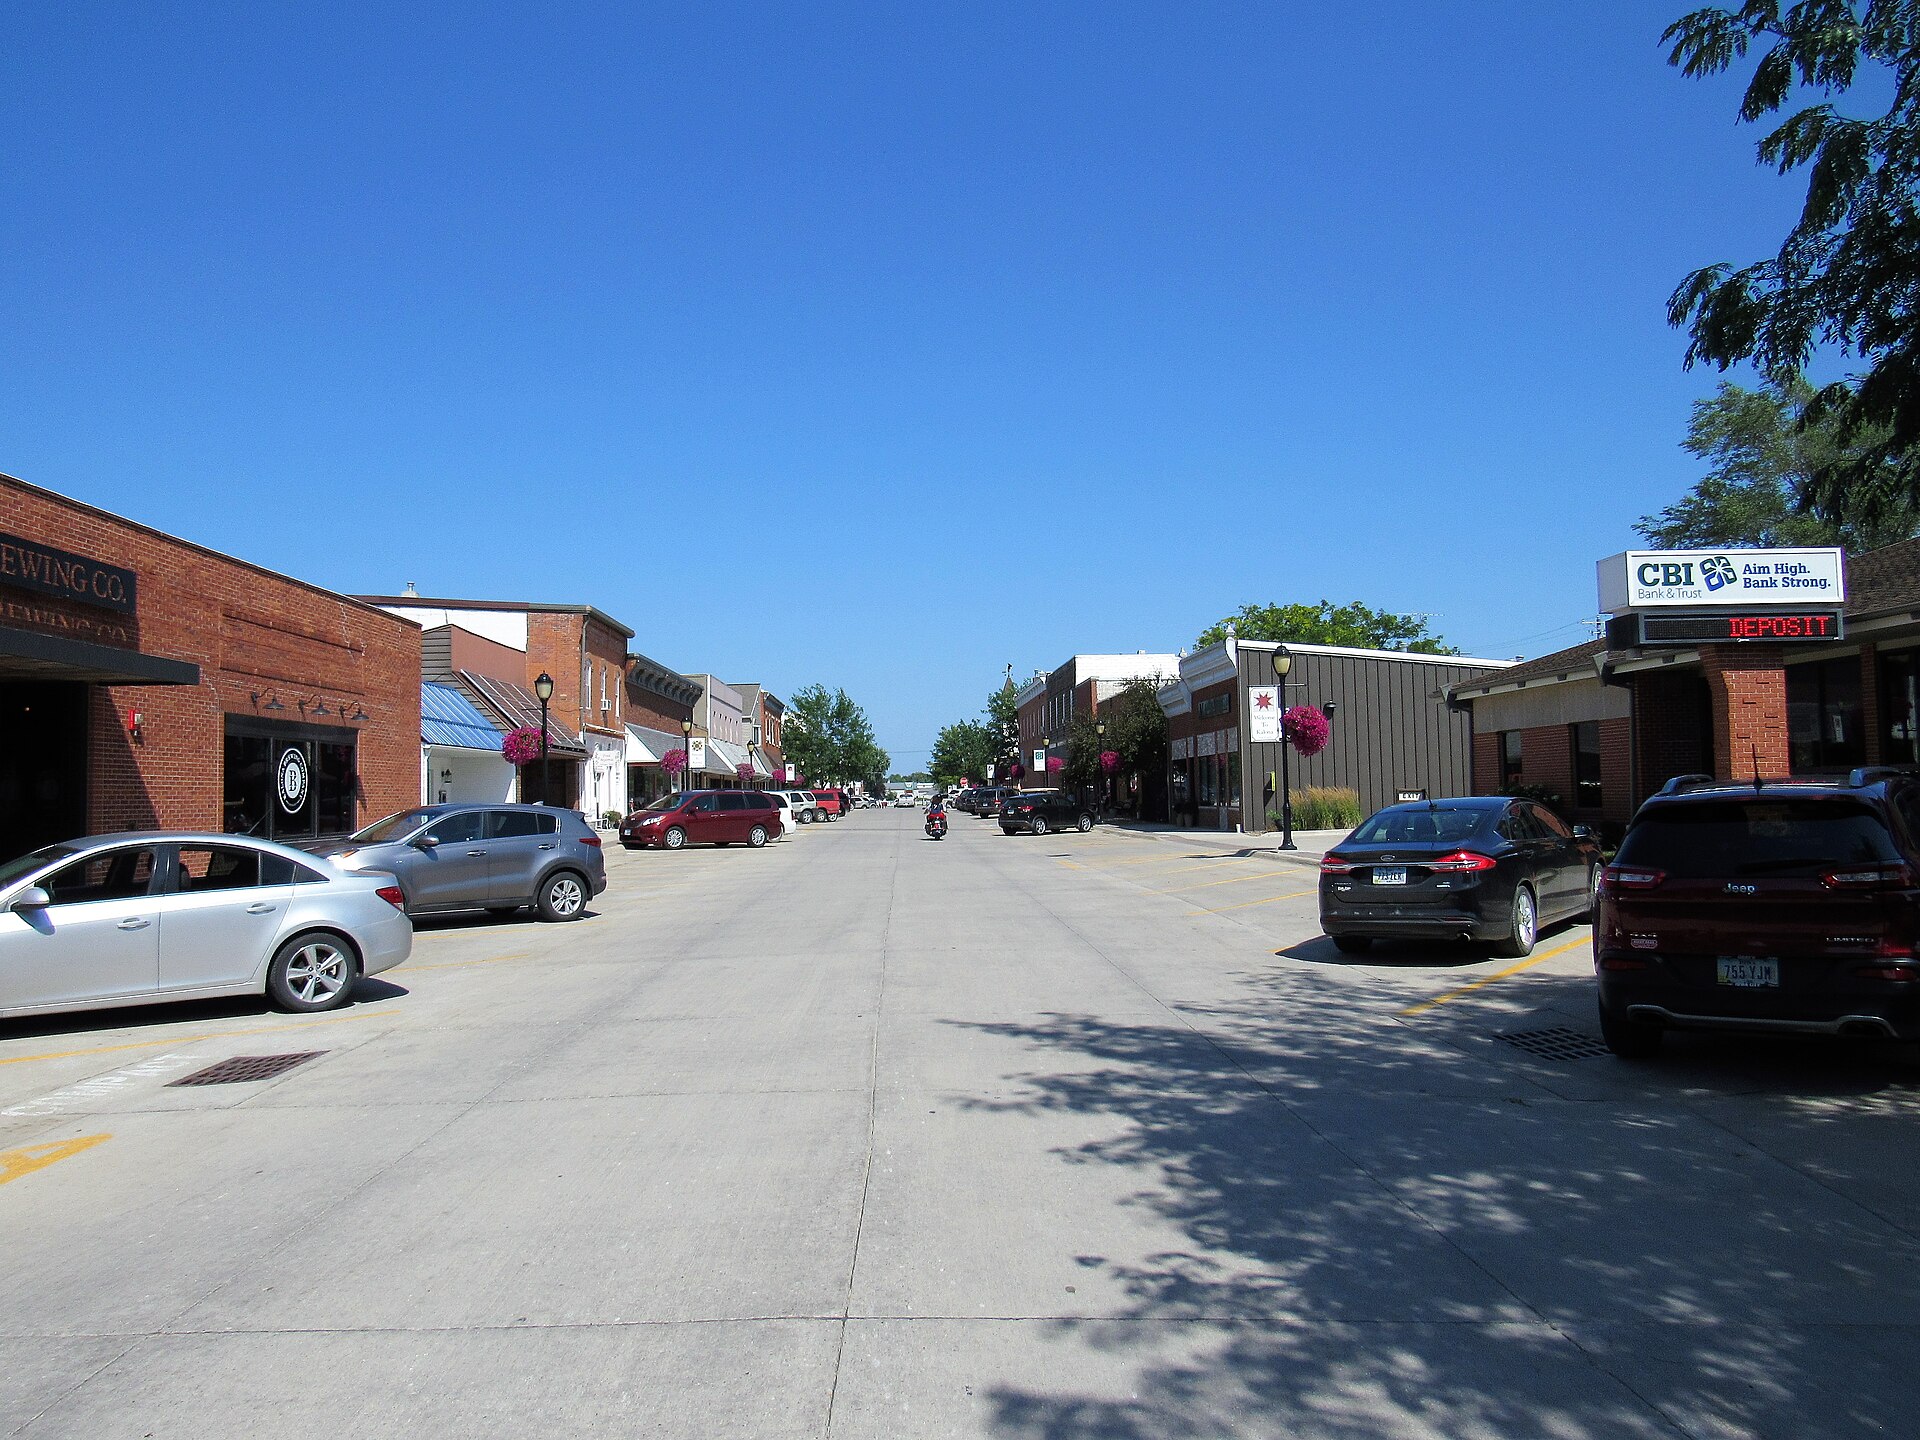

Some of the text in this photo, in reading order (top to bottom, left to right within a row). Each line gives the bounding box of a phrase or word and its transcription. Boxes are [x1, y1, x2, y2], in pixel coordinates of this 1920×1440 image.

[1637, 563, 1694, 586] CBI
[1742, 563, 1811, 578] Aim High.
[92, 570, 127, 603] CO.
[1743, 575, 1831, 591] Bank Strong.
[1638, 588, 1702, 599] Bank & Trust
[1729, 617, 1829, 637] DEPOSIT
[1722, 882, 1756, 895] Jeep
[1724, 964, 1746, 980] 755
